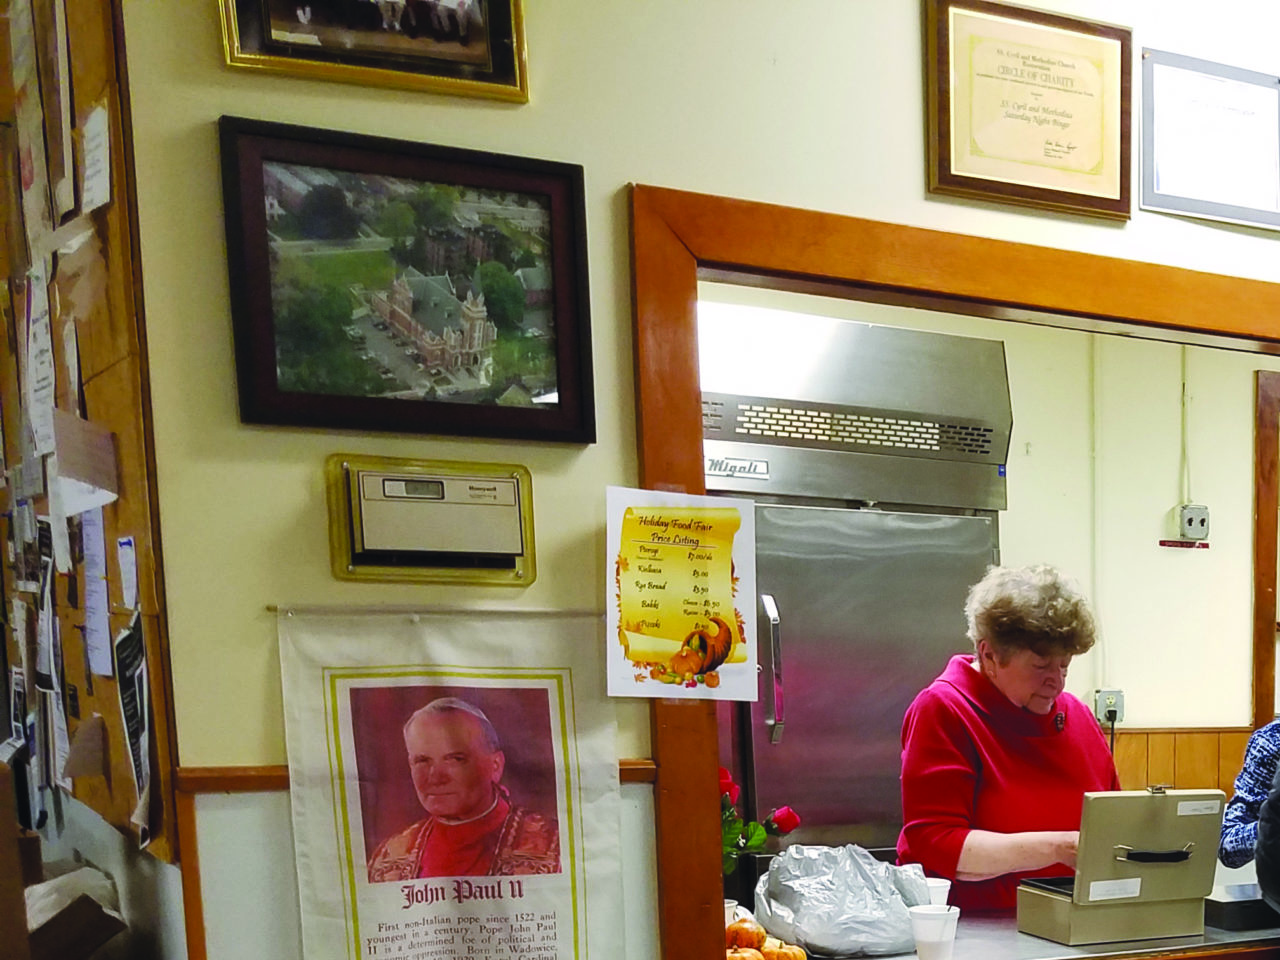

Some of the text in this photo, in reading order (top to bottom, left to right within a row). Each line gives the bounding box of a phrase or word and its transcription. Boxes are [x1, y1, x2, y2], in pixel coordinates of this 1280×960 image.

[998, 65, 1025, 78] CIRCLE
[1027, 70, 1038, 81] OF
[1040, 72, 1074, 88] CHARITY
[640, 516, 713, 533] Holiday Food Fair
[651, 532, 700, 550] Price Listing
[635, 580, 668, 592] Rye Bread
[400, 883, 446, 910] John
[452, 879, 504, 904] Paul
[378, 911, 556, 933] First non-Italian pope since 1522 and
[367, 933, 407, 946] youngest
[412, 930, 420, 938] in
[480, 924, 503, 936] Pope
[510, 924, 531, 934] John
[536, 921, 556, 932] Paul
[368, 946, 377, 956] II
[384, 945, 392, 954] is
[408, 936, 454, 950] determined
[462, 936, 476, 945] foe
[481, 935, 491, 945] of
[498, 934, 535, 945] political
[540, 932, 557, 942] and
[467, 945, 490, 954] Born
[496, 945, 504, 954] in
